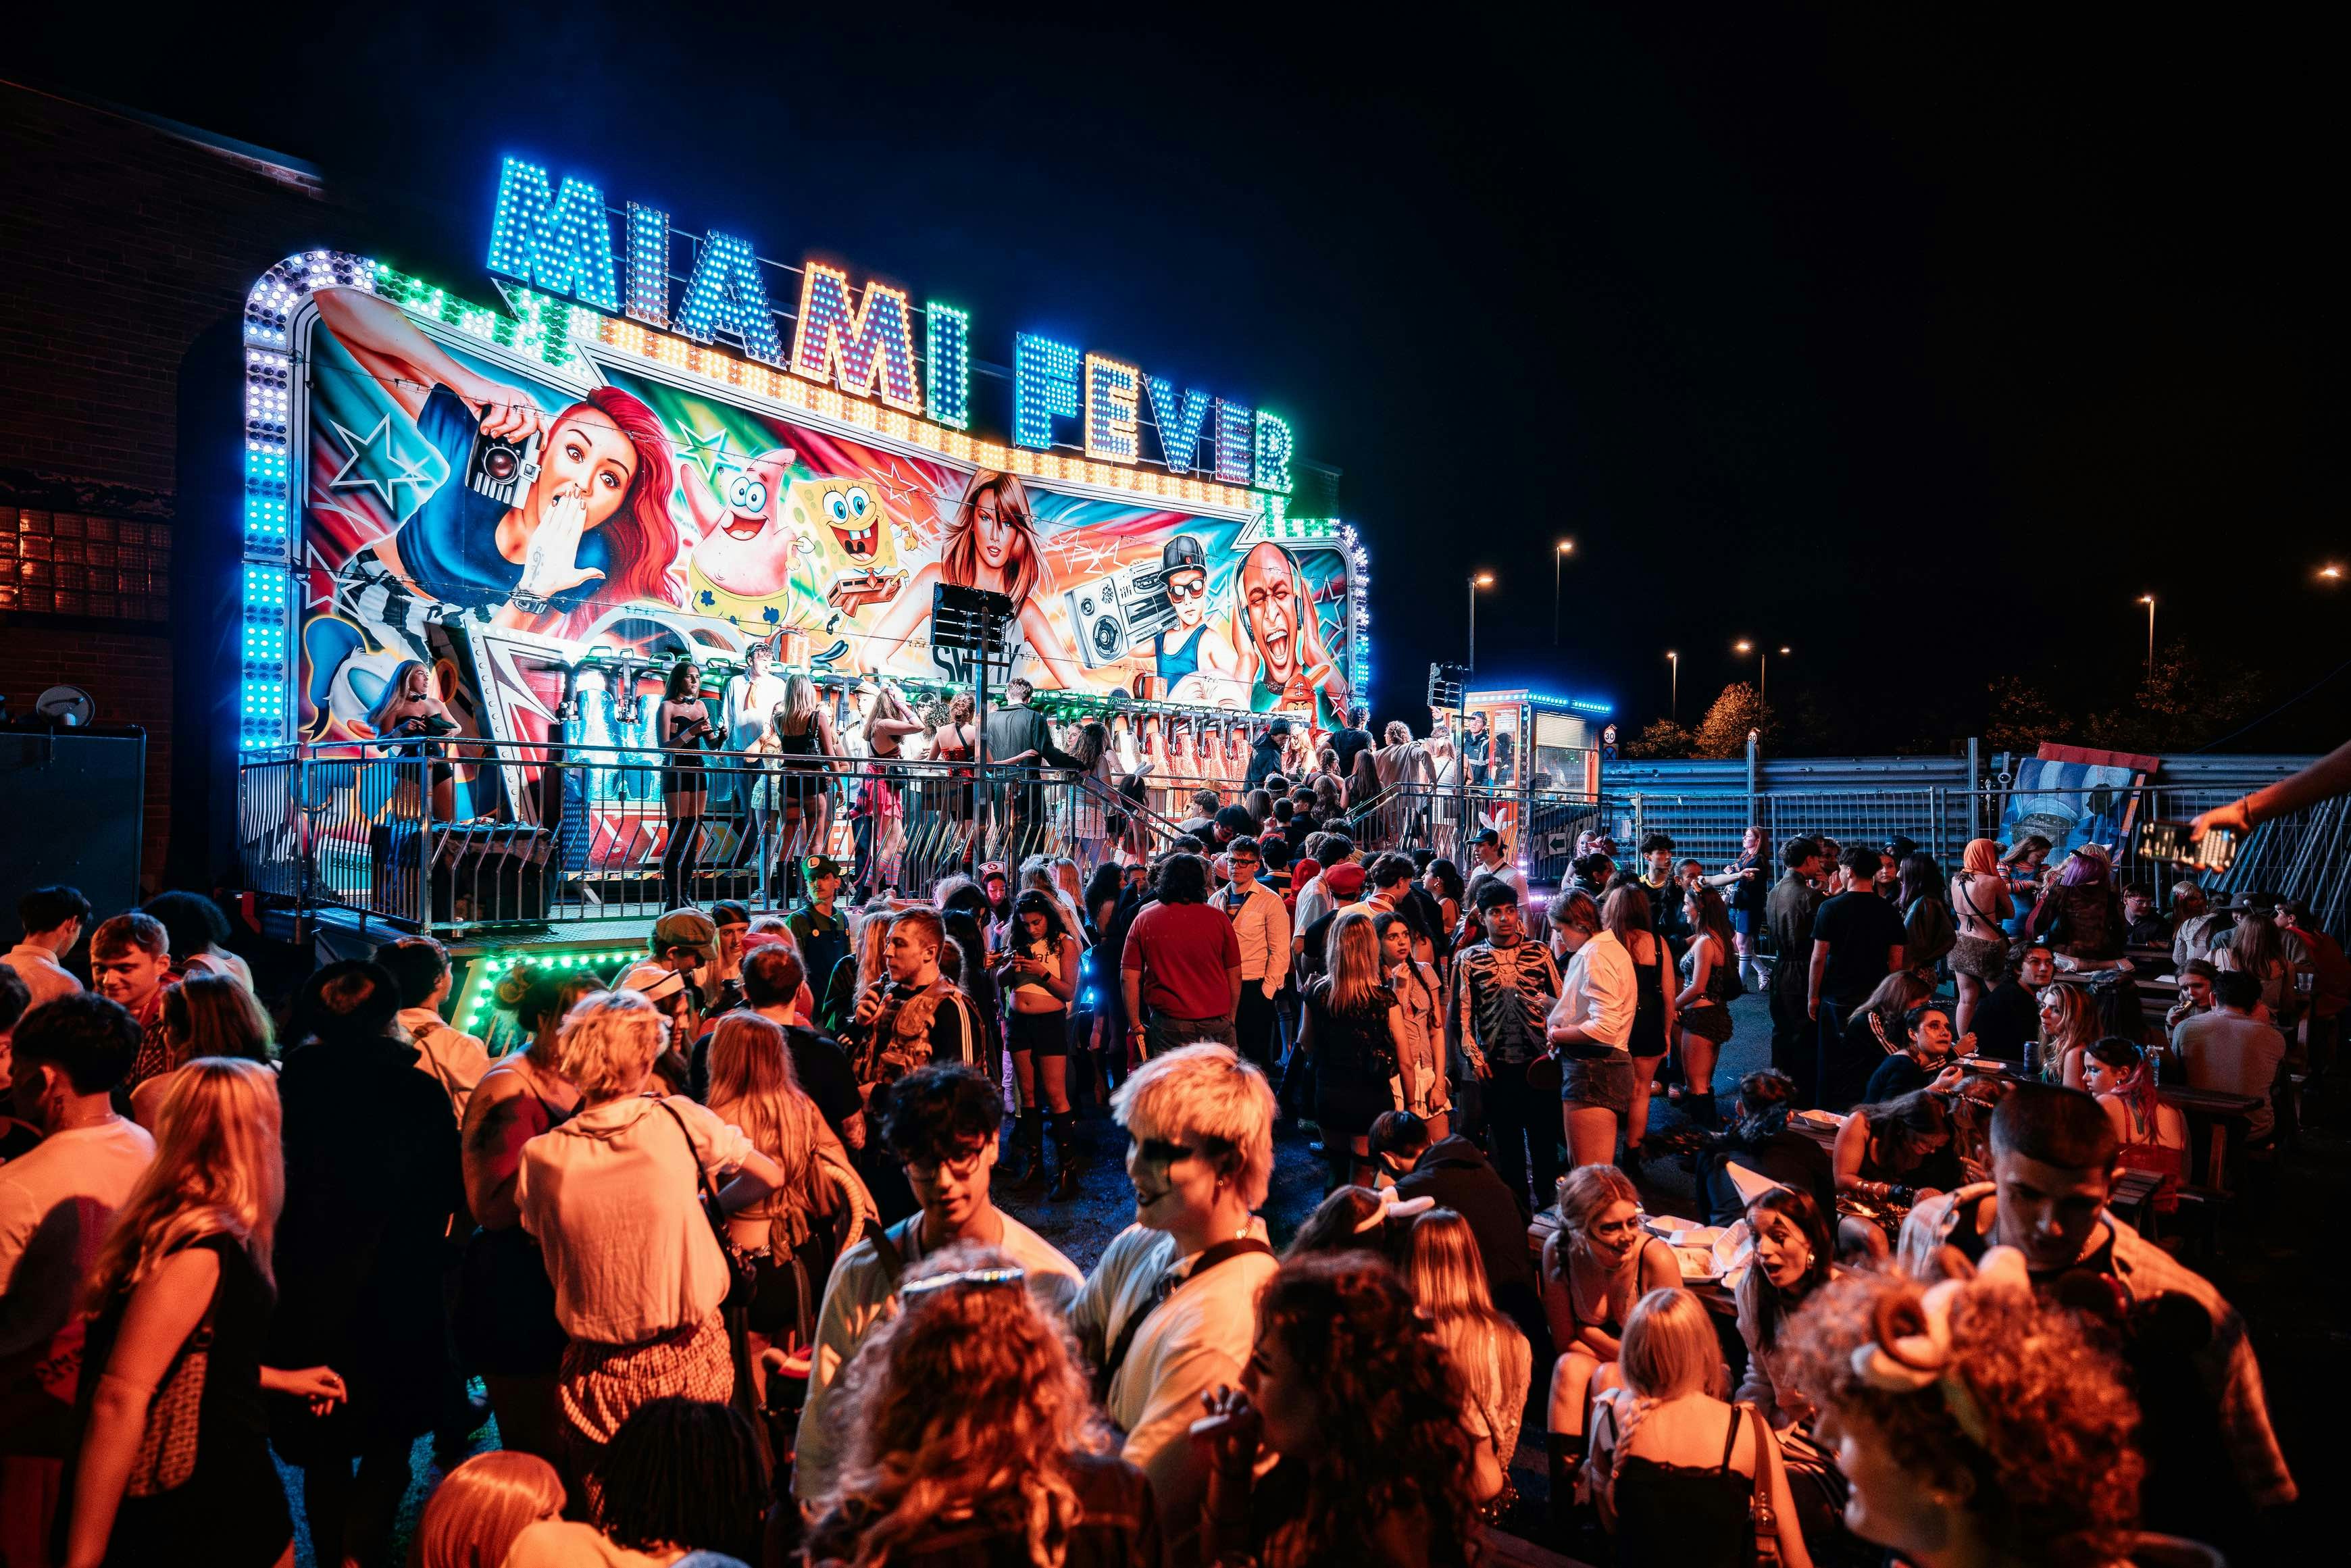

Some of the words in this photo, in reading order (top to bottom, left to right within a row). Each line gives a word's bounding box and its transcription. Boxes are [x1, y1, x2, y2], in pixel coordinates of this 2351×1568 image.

[486, 156, 968, 429] MIAMI
[1015, 331, 1293, 493] FEVER
[932, 642, 1021, 684] SWTY
[1604, 732, 1615, 740] 30
